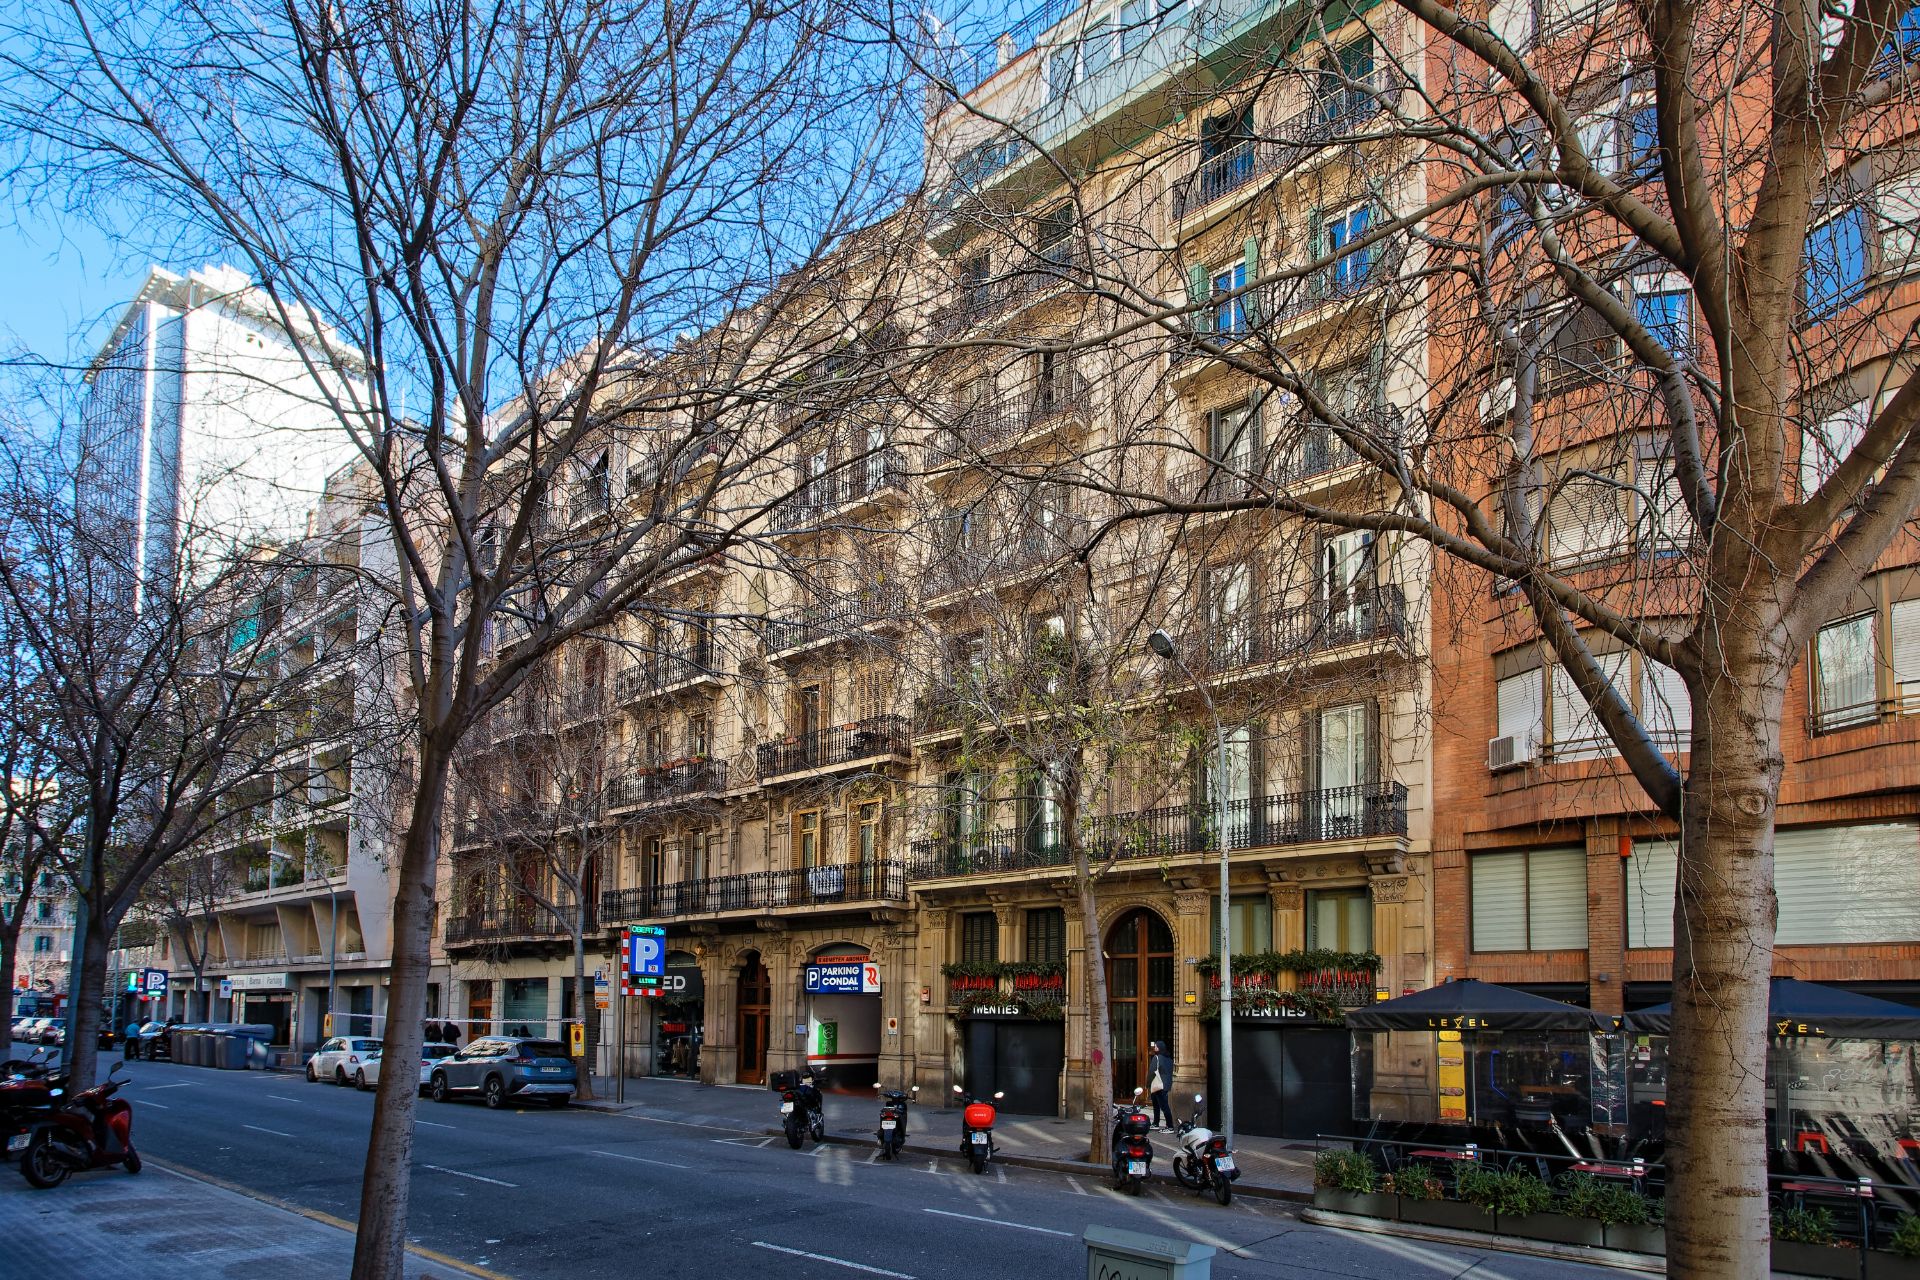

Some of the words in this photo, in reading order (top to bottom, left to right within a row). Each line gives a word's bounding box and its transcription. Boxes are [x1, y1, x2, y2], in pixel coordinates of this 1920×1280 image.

[631, 926, 654, 934] OBERT
[635, 937, 659, 972] P
[821, 966, 860, 976] PARKING
[146, 971, 164, 990] P
[809, 971, 818, 986] P
[821, 976, 859, 986] CONDAL
